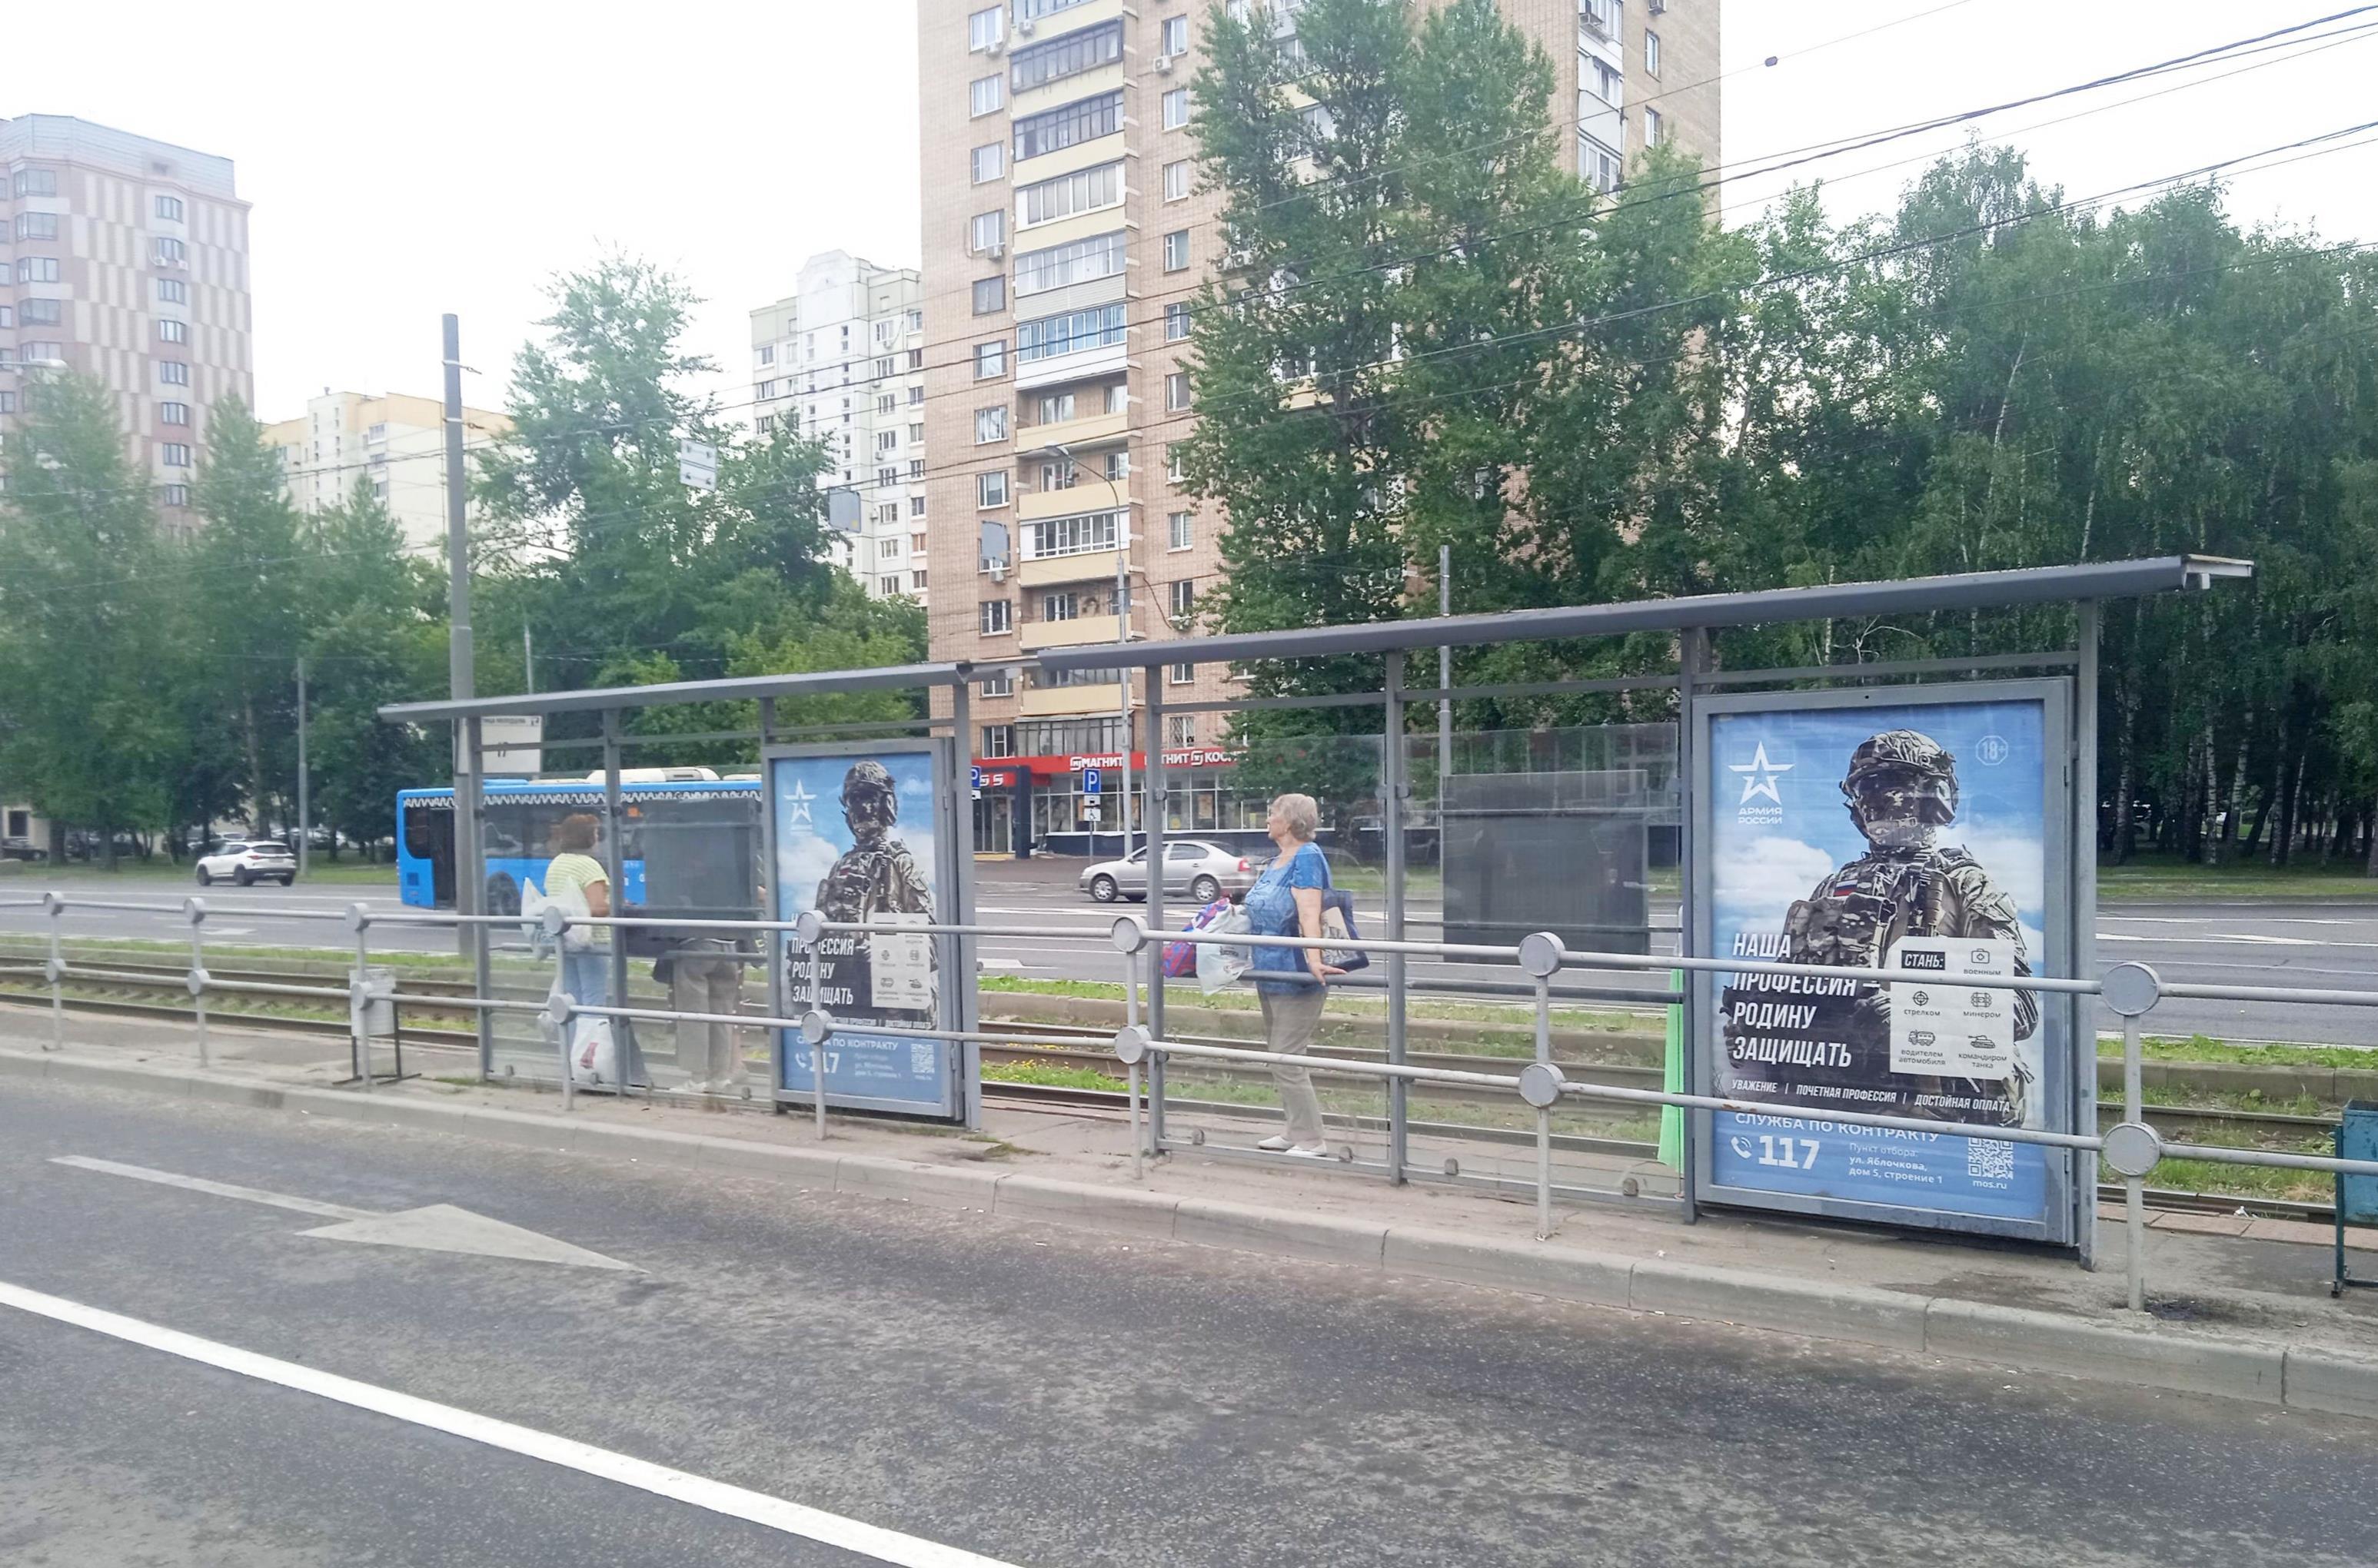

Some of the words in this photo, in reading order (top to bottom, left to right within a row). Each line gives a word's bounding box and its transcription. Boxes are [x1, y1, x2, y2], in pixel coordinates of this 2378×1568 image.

[1982, 740, 2006, 759] 18+
[1082, 756, 1123, 768] МАГНИТ
[1088, 771, 1098, 792] P
[1738, 807, 1782, 816] АРМИЯ
[791, 937, 855, 955] ПРОЕССИЯ
[1732, 932, 1792, 959] НАША
[1904, 953, 1944, 968] СТАНЬ:
[792, 961, 836, 980] РОДНУ
[1732, 972, 1858, 998] ПРОФЕССИЯ
[1732, 1002, 1818, 1030] РОДИНУ
[1904, 1009, 1941, 1018] стрелком
[1963, 1011, 2001, 1019] минером
[1732, 1036, 1852, 1068] ЗАЩИЩАТЬ
[1901, 1049, 1944, 1058] водителем
[1958, 1053, 2007, 1063] командиром
[1898, 1056, 1947, 1067] автомобиля
[1731, 1079, 1778, 1093] УВАЖЕНИЕ
[1796, 1084, 1841, 1098] ПОЧЕТНАЯ
[1842, 1088, 1897, 1103] ПРОФЕССИЯ
[1914, 1094, 1971, 1109] ДОСТОЙНАЯ
[1972, 1099, 2010, 1113] ОПЛАТА
[1734, 1112, 1804, 1131] СЛУЖБА
[1809, 1119, 1834, 1132] ПО
[1838, 1123, 1940, 1143] КОНТРАКТУ
[1758, 1134, 1821, 1171] 117
[1849, 1142, 1878, 1154] Пункт
[1881, 1148, 1919, 1158] отбора:
[1849, 1156, 1864, 1165] ул.
[1866, 1157, 1927, 1172] Яблочкова,
[1848, 1168, 1871, 1177] дом
[1873, 1168, 1882, 1178] 5,
[1884, 1171, 1934, 1184] строение
[1972, 1181, 2007, 1190] mos.ru
